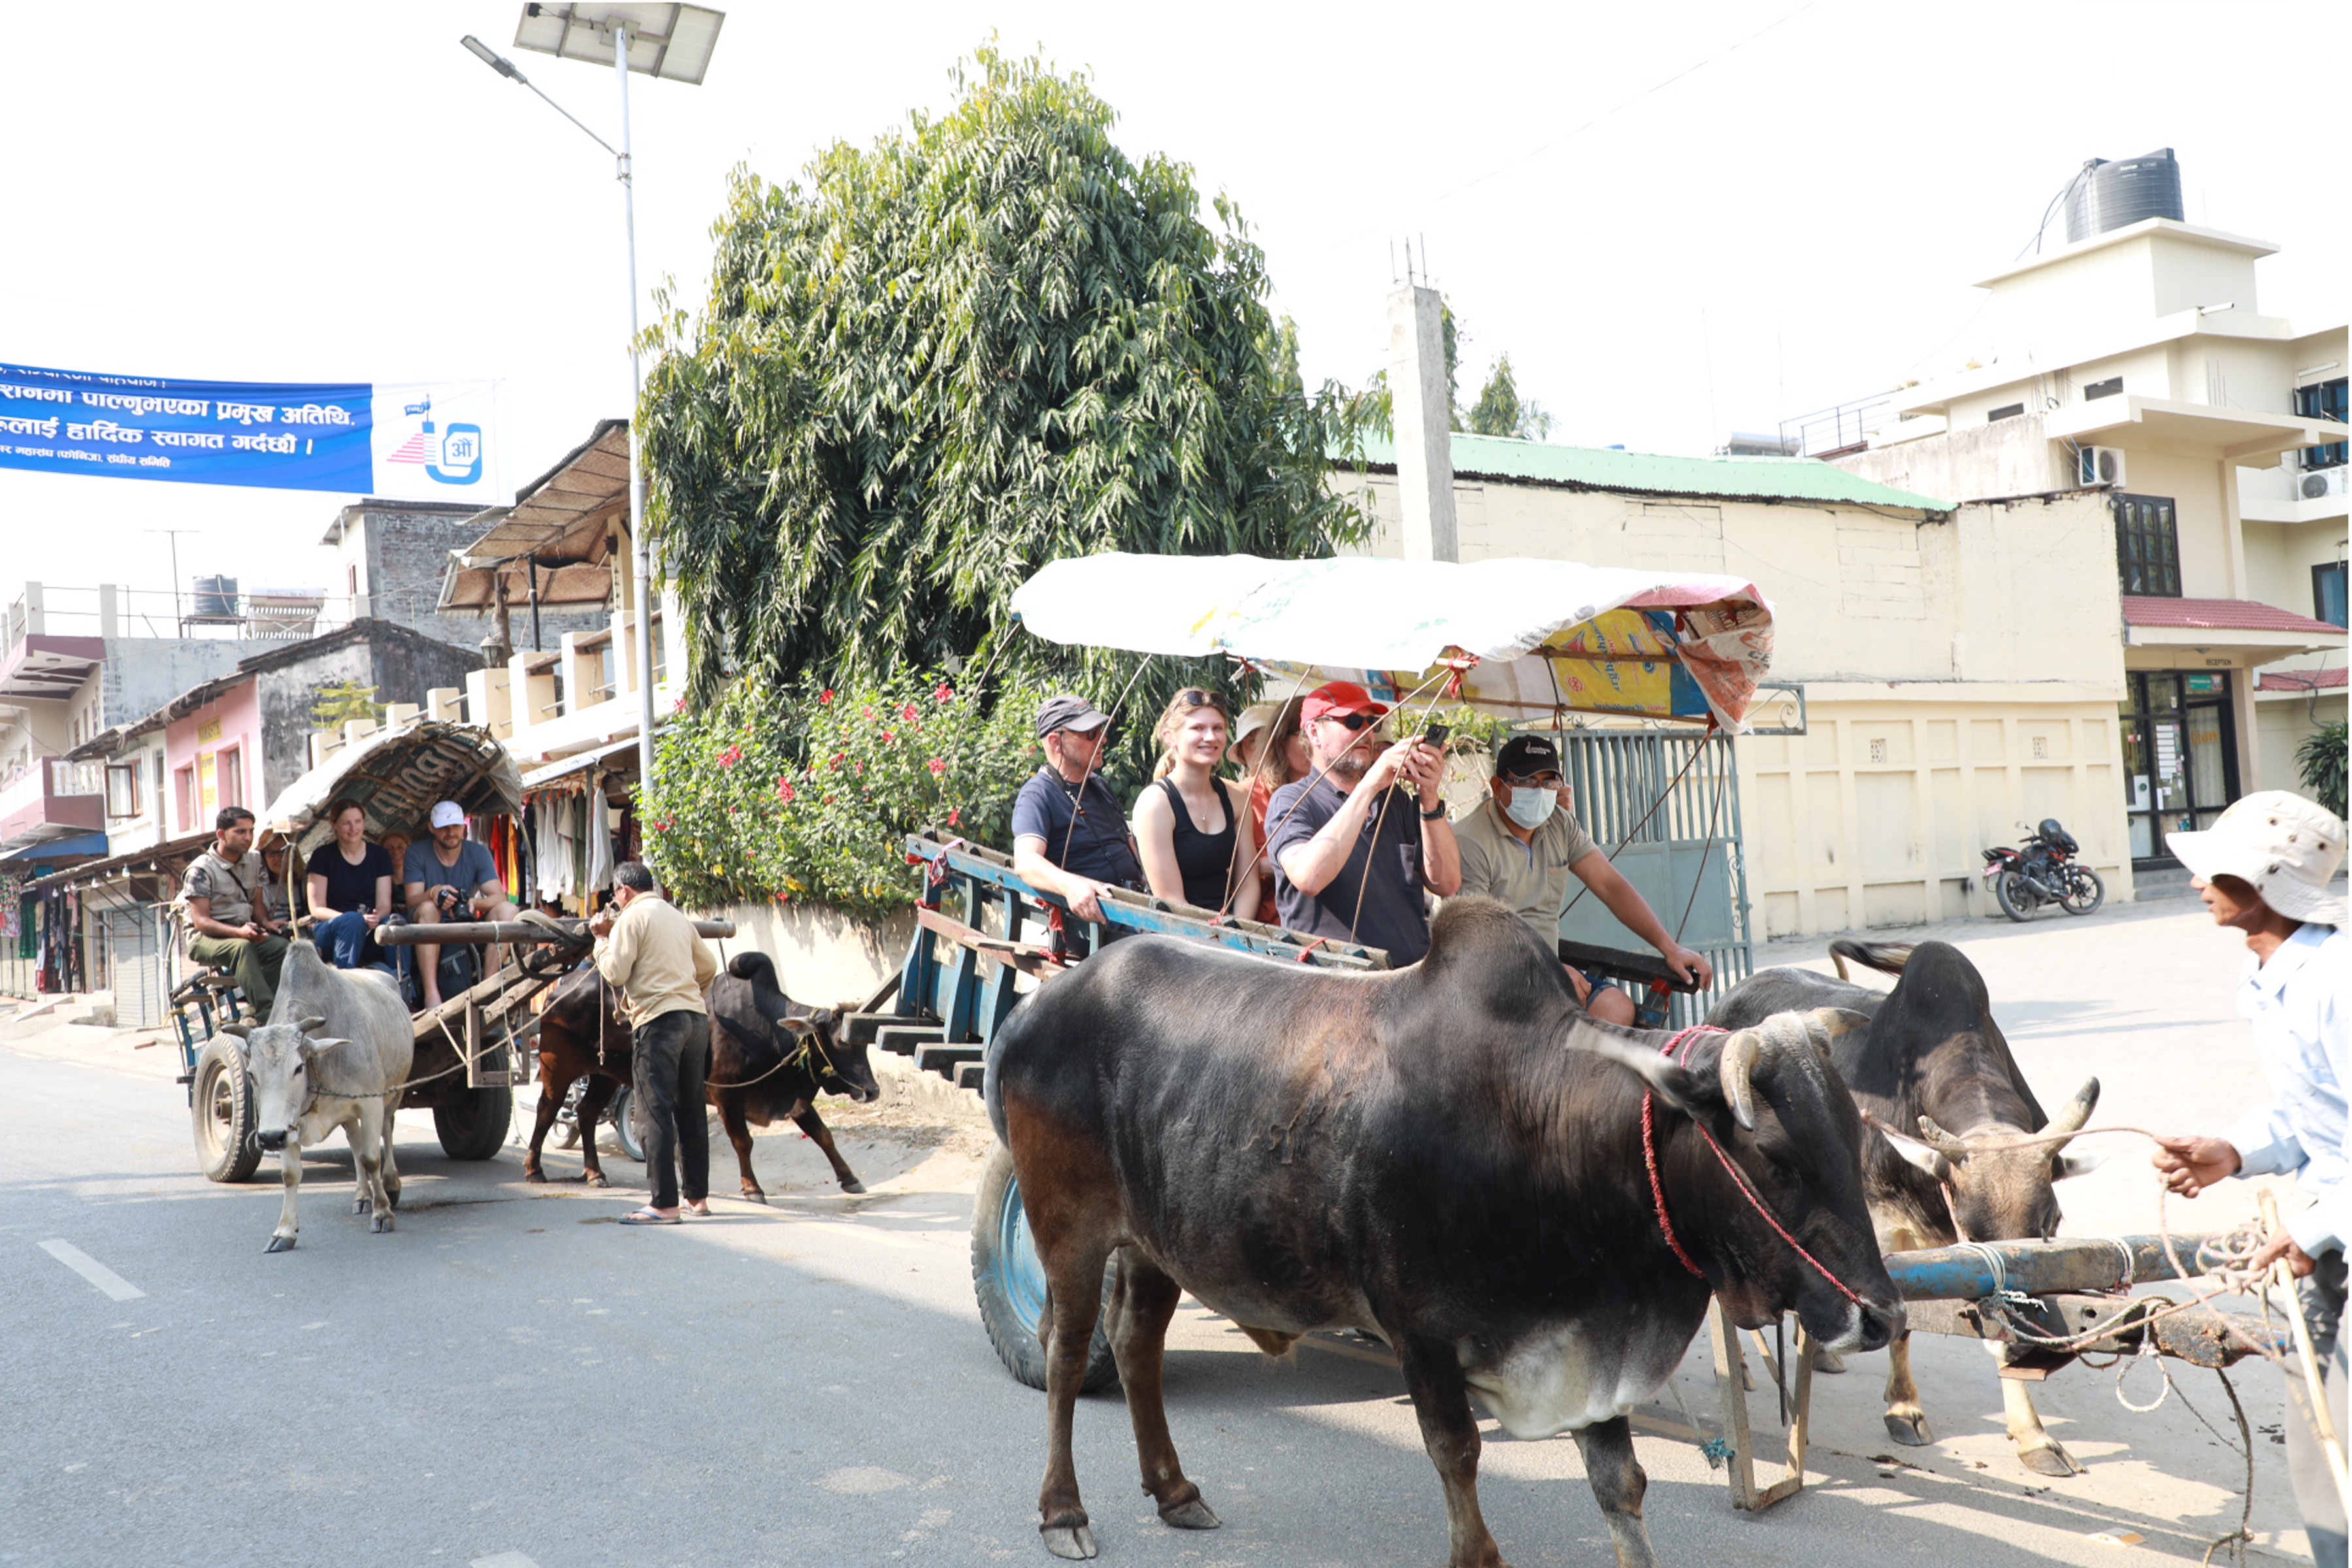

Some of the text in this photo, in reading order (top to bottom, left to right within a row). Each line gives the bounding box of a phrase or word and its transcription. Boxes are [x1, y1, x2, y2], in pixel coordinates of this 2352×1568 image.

[81, 391, 210, 416] पाल्नुभएका
[216, 402, 275, 425] प्रमुख
[67, 419, 144, 443] हार्दिक
[151, 430, 224, 449] स्वागत
